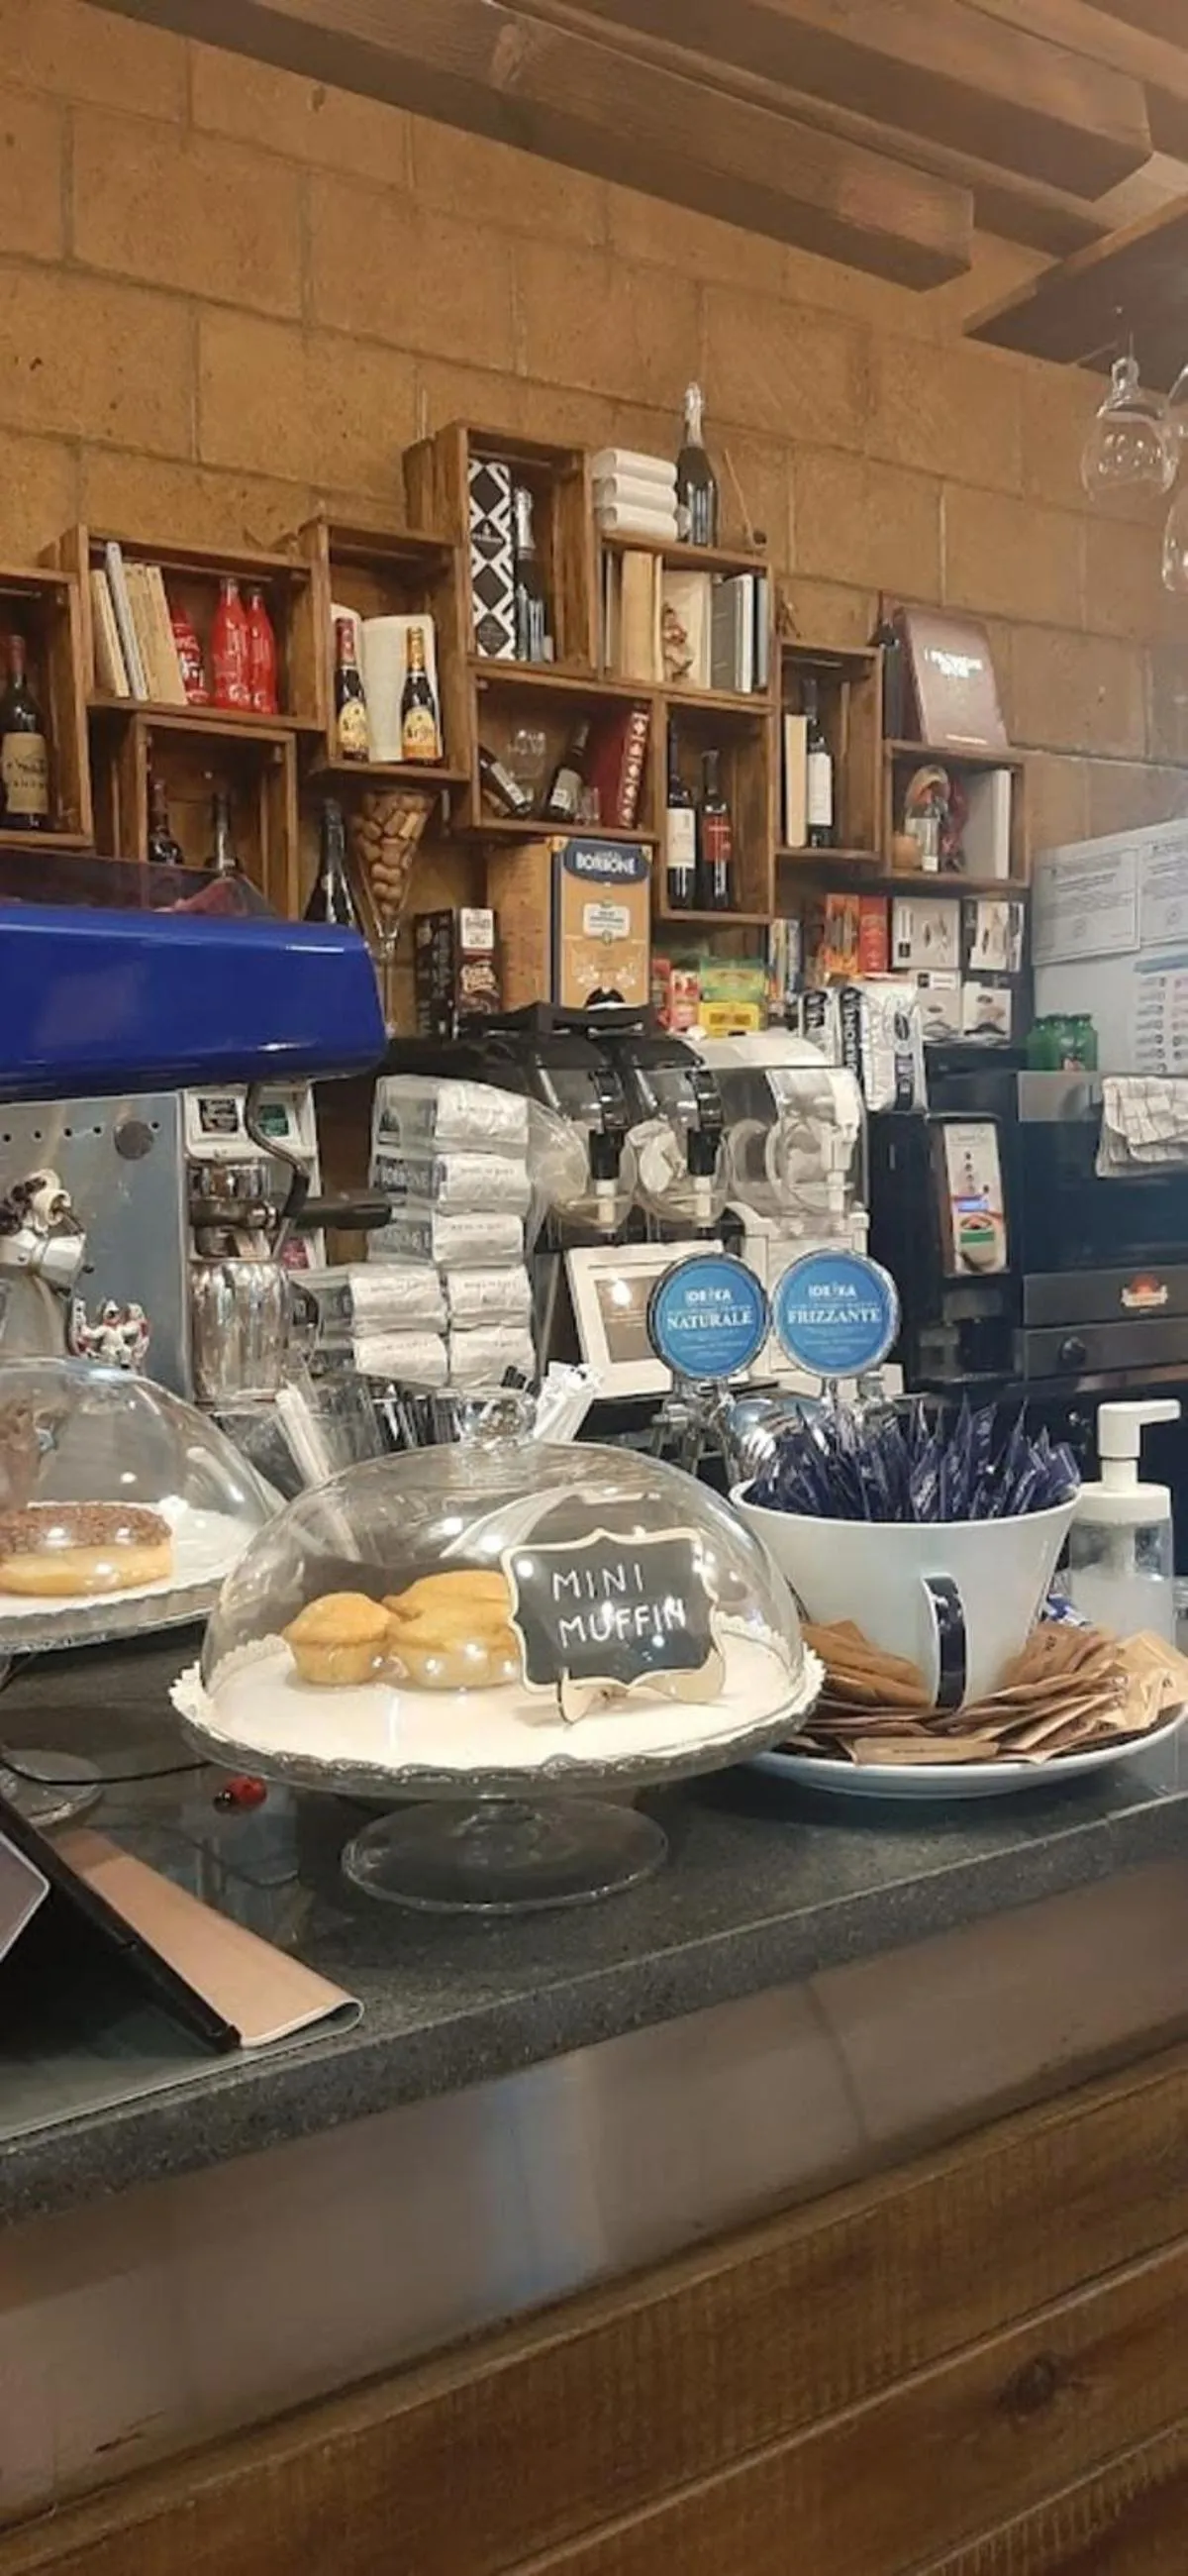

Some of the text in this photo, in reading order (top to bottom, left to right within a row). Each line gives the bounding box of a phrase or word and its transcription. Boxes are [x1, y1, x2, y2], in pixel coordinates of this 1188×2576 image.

[667, 1310, 753, 1331] NATURALE
[787, 1306, 882, 1324] FRIZZANTE
[552, 1563, 644, 1600] MINI
[558, 1595, 686, 1649] MUFFIN
